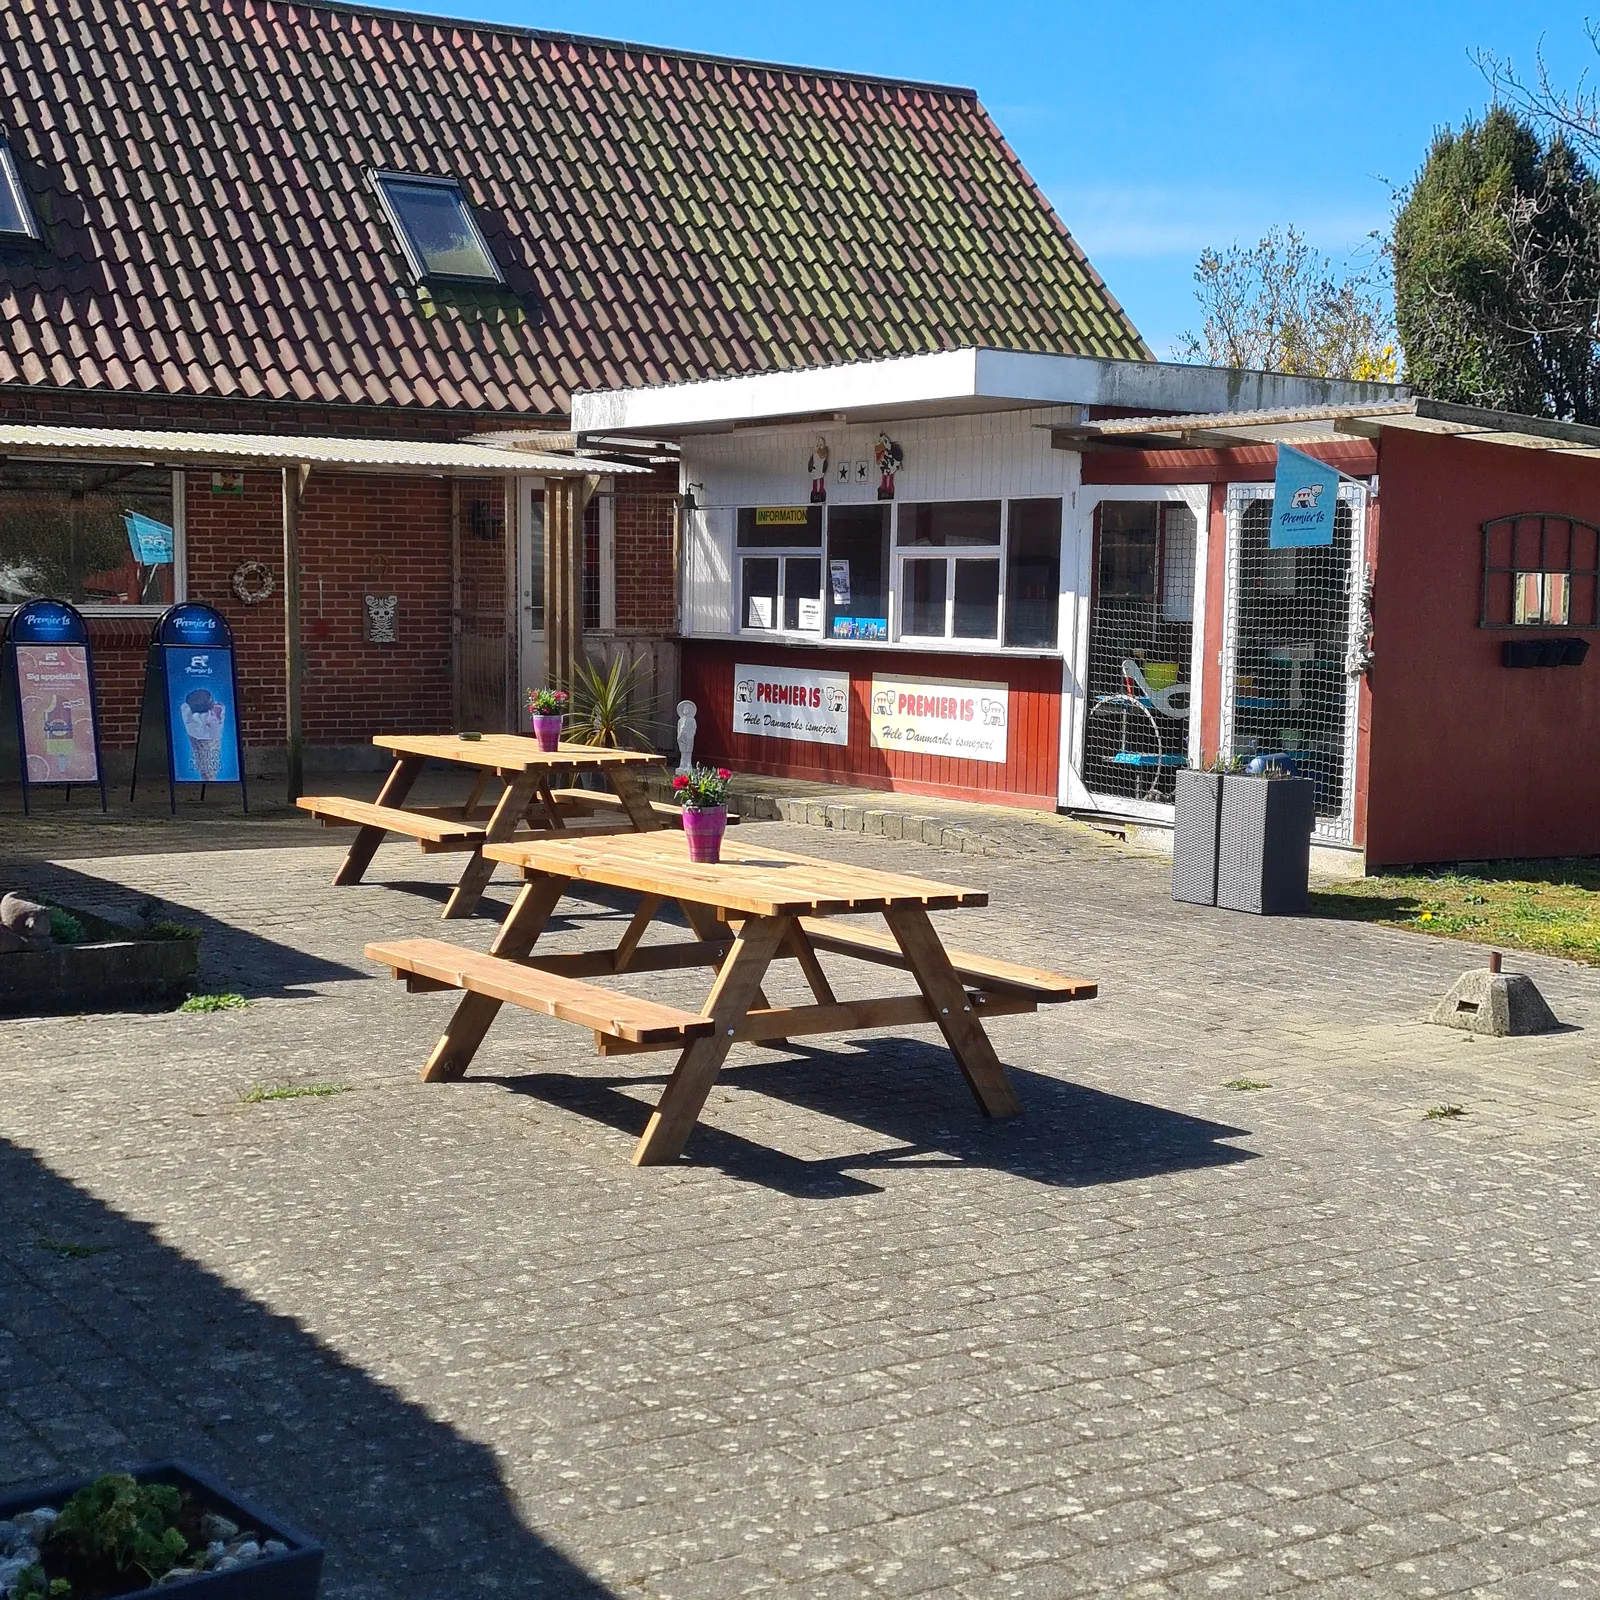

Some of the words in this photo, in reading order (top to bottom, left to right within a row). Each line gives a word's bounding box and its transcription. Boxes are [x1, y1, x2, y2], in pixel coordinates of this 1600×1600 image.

[757, 509, 808, 522] INFORMATION
[1280, 511, 1316, 526] Premier
[24, 614, 61, 626] Premier
[173, 617, 208, 629] Premier
[756, 682, 807, 708] PREMIER
[808, 687, 821, 709] IS
[898, 693, 958, 721] PREMIER
[960, 698, 975, 722] IS
[743, 712, 761, 726] Hele
[763, 714, 804, 731] Danmarks
[805, 721, 838, 737] ismejeri
[882, 725, 903, 740] Hele
[905, 727, 953, 746] Danmarks
[955, 735, 994, 752] ismejeri
